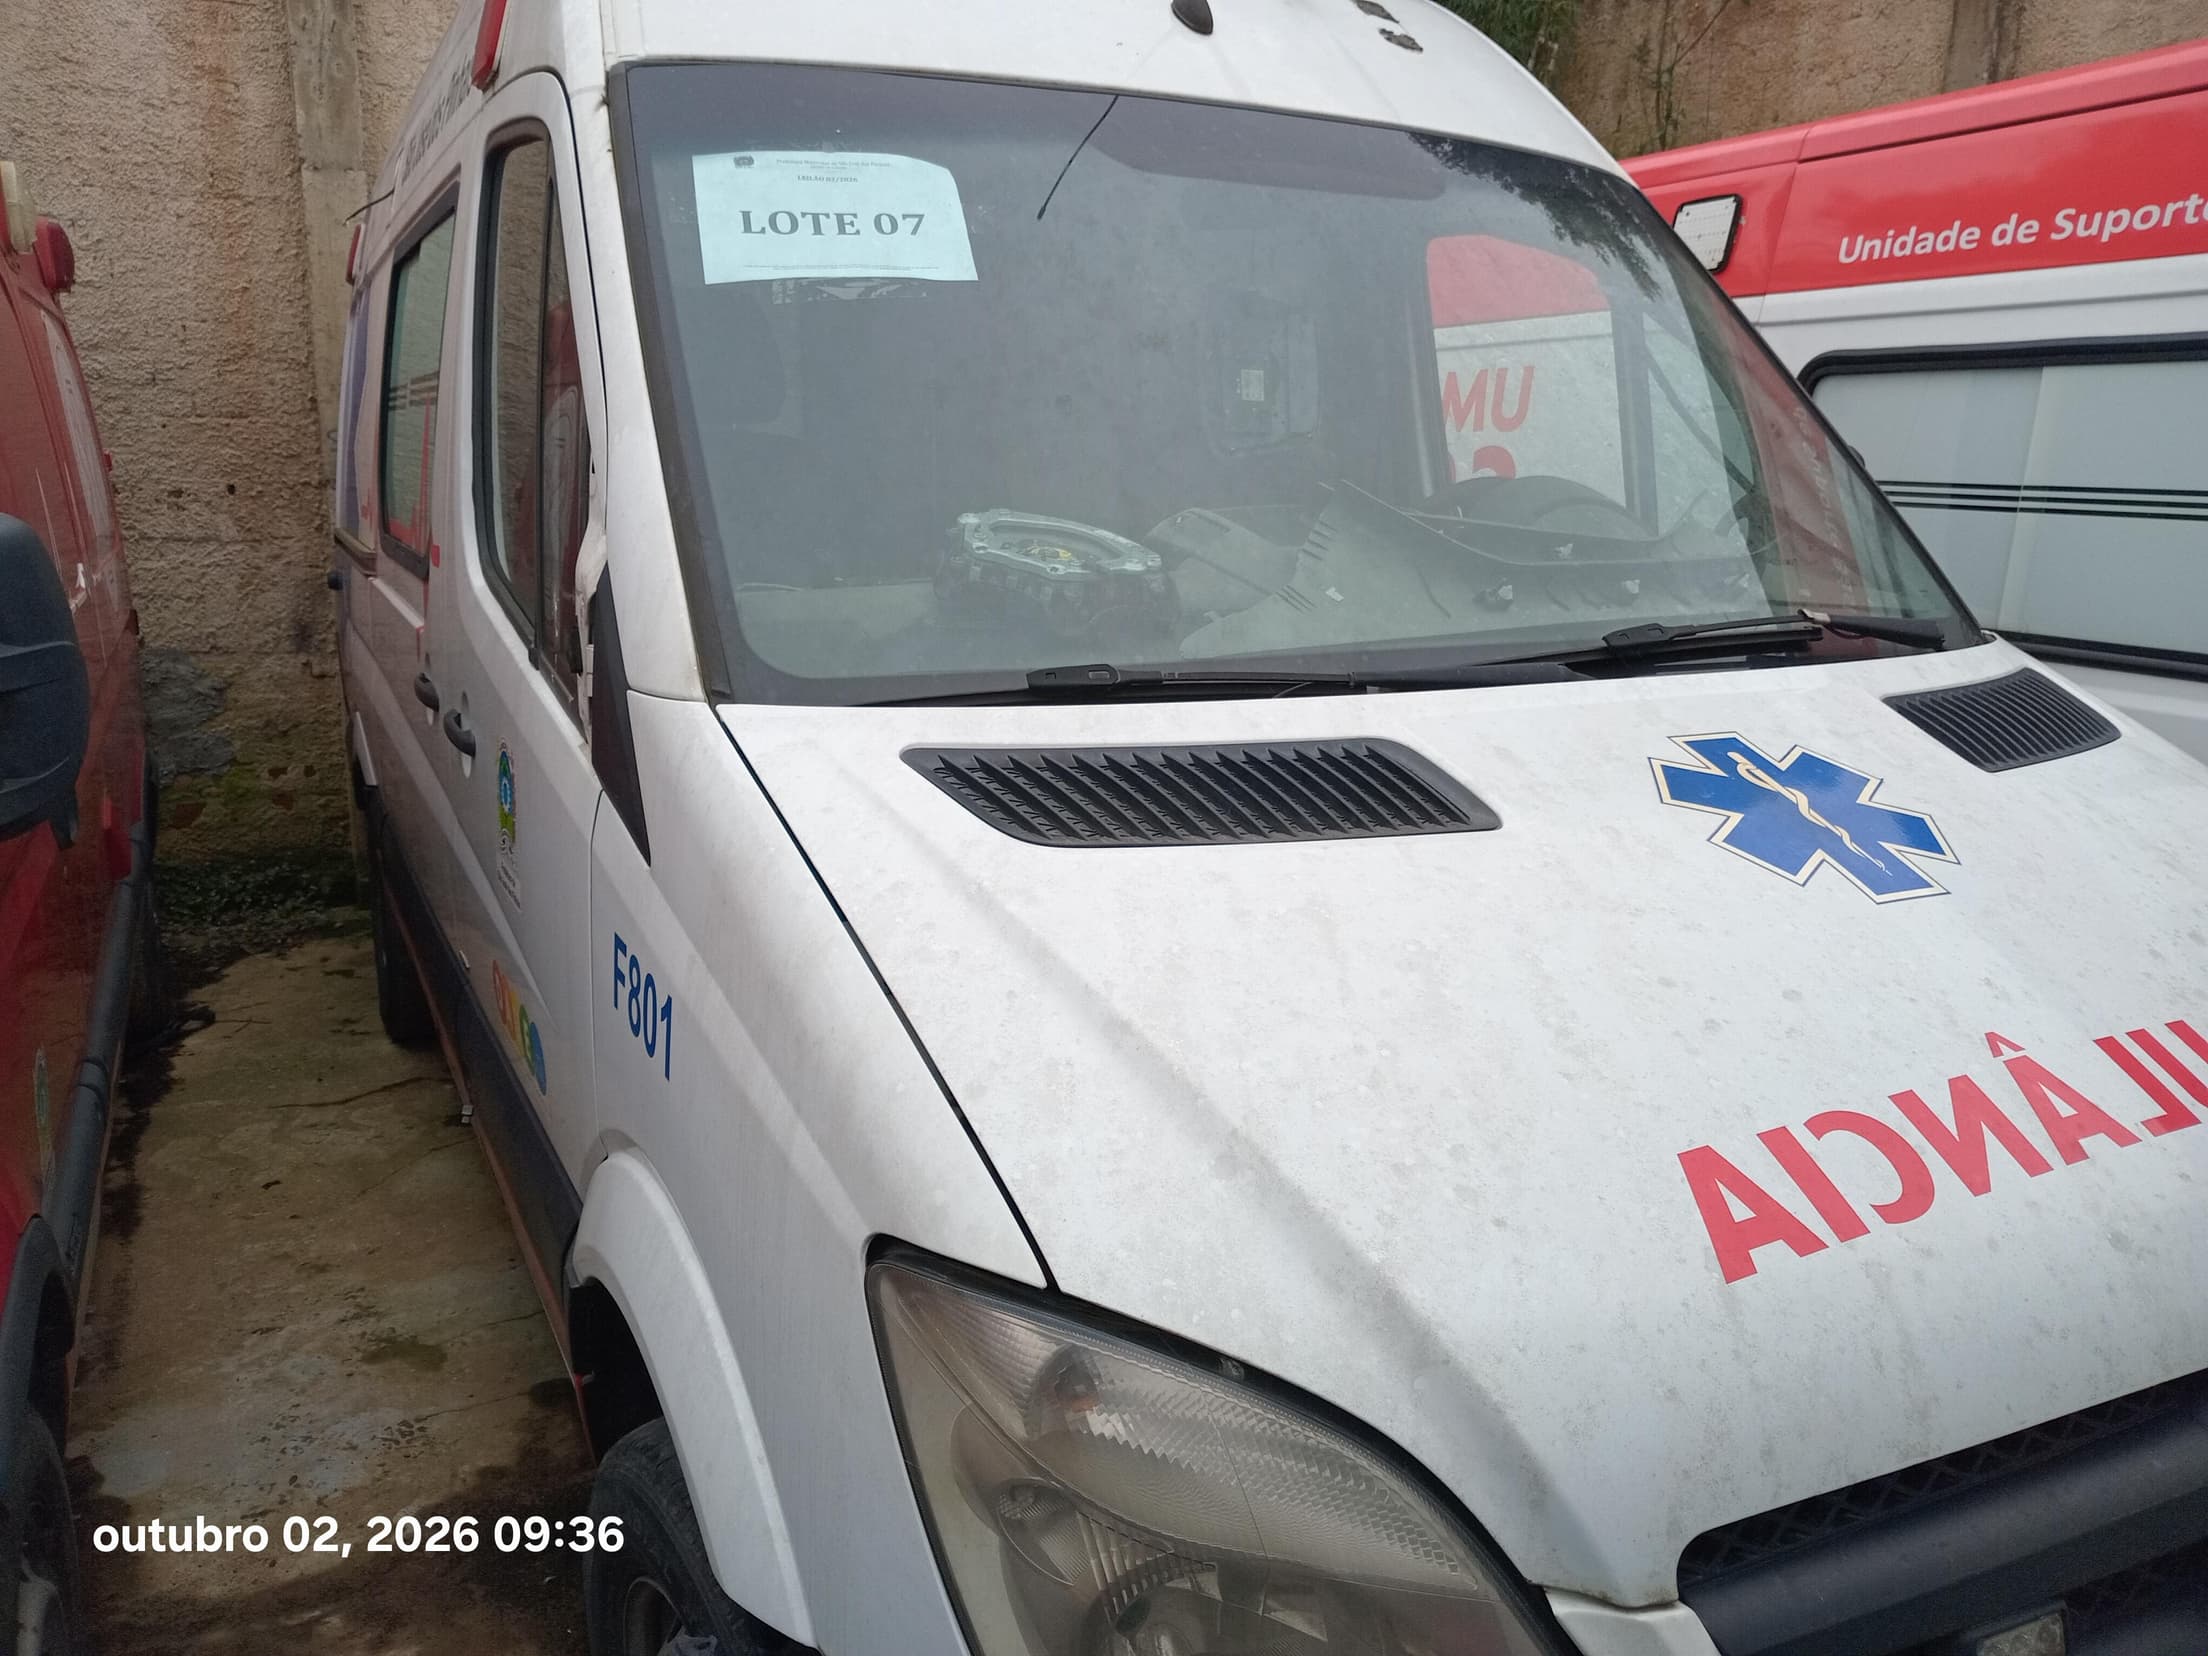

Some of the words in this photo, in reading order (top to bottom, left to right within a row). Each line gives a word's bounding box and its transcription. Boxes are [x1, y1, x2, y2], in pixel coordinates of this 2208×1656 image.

[739, 210, 861, 236] LOTE
[873, 212, 926, 236] 07
[1837, 219, 1980, 265] Unidade
[1991, 213, 2040, 247] de
[613, 931, 673, 1082] F801
